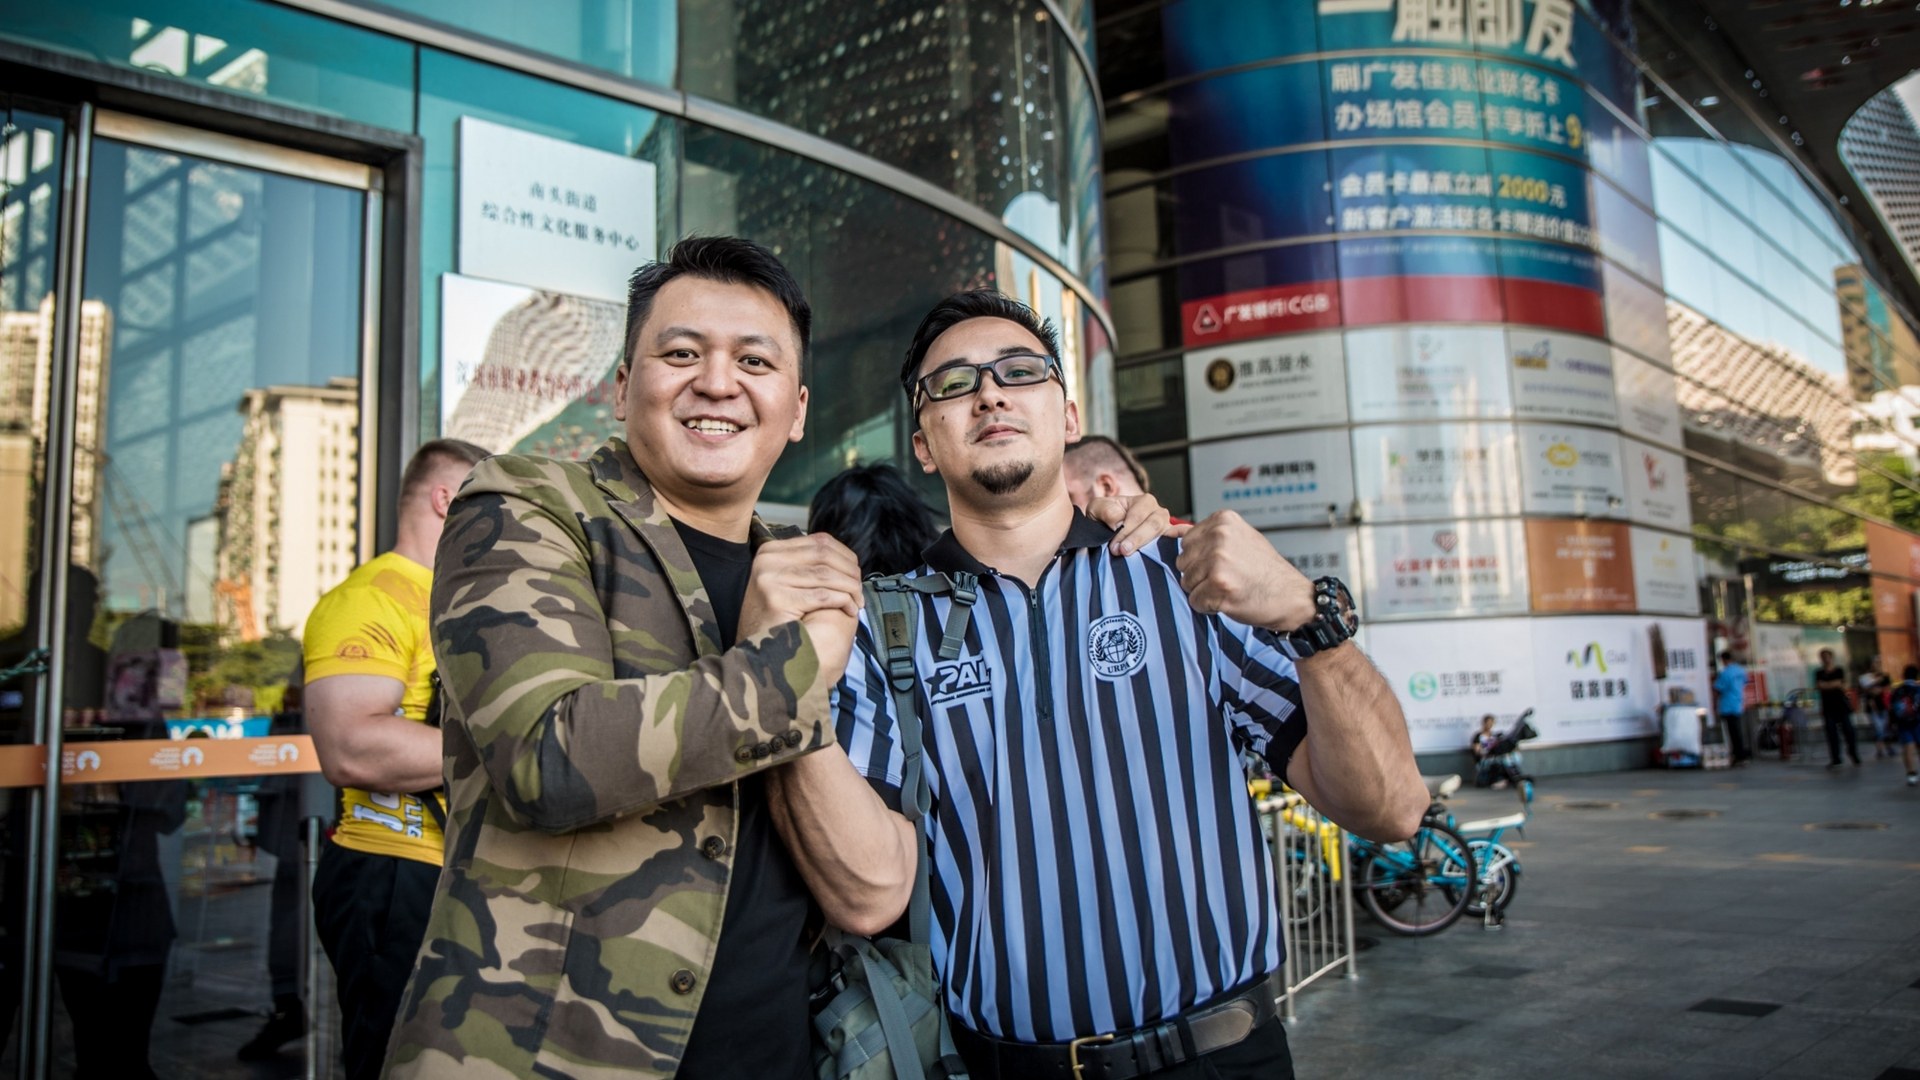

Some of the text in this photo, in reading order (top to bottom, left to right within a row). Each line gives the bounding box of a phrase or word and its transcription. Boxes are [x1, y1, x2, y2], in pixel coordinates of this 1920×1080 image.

[1331, 61, 1560, 105] 刷广发佳兆业联名卡
[1335, 100, 1592, 150] 办场馆会员卡享折上9
[529, 182, 597, 212] 南头街道
[481, 201, 639, 251] 综合性文化服务中心
[1223, 293, 1330, 325] 广发银行 CGB
